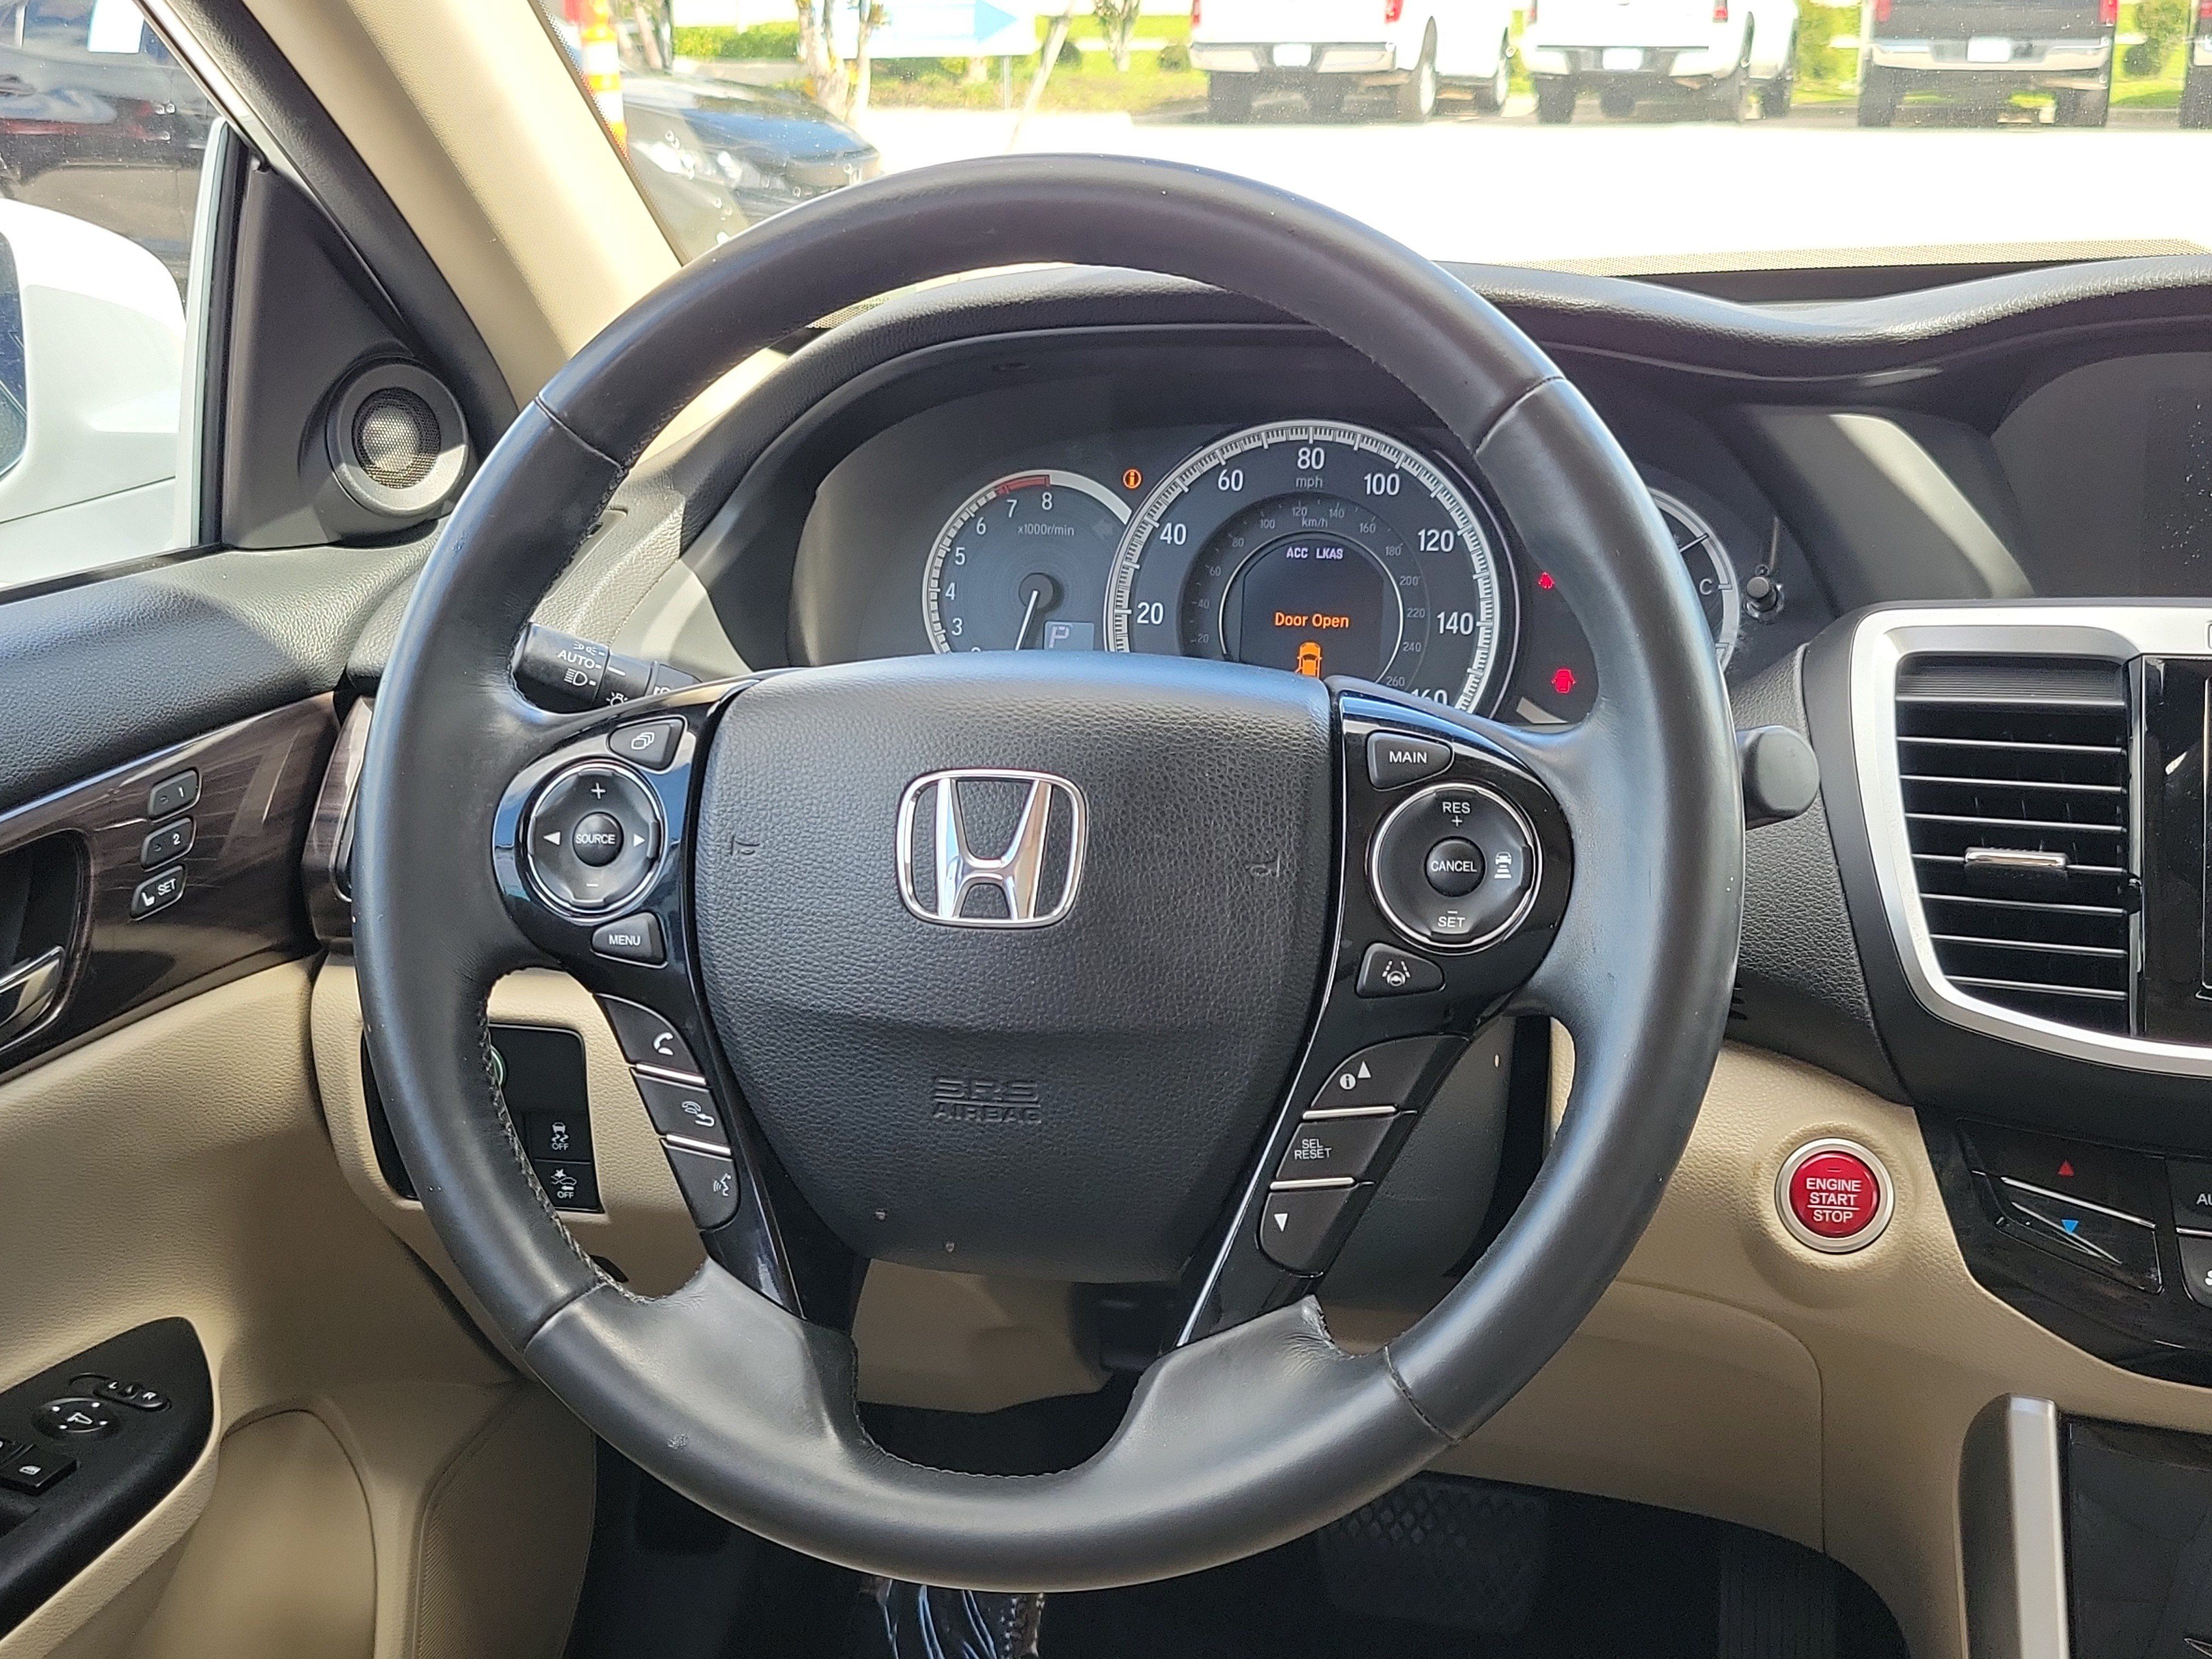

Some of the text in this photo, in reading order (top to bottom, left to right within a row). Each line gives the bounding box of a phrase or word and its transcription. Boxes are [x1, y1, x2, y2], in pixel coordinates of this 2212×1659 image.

[1297, 448, 1325, 470] 80
[1218, 470, 1244, 492] 60
[1296, 476, 1323, 489] mph
[1364, 473, 1400, 496] 100
[1041, 492, 1053, 510] 8
[1007, 500, 1019, 518] 7
[1292, 506, 1307, 517] 120
[1329, 508, 1345, 518] 140
[977, 517, 986, 535] 6
[1260, 519, 1276, 529] 100
[1302, 517, 1328, 528] km/h
[1359, 522, 1376, 533] 160
[1018, 524, 1075, 537] x1000r/min
[1160, 523, 1187, 545] 40
[1232, 537, 1245, 548] 80
[1418, 529, 1455, 552] 120
[955, 548, 966, 566] 5
[1286, 547, 1344, 560] ACC LKAS
[1386, 546, 1401, 556] 180
[1209, 566, 1221, 577] 60
[1400, 575, 1419, 585] 200
[1699, 578, 1713, 595] C
[945, 583, 956, 600] 4
[1198, 599, 1210, 609] 40
[1137, 602, 1164, 624] 20
[1407, 608, 1426, 618] 220
[951, 618, 963, 636] 3
[1275, 612, 1349, 629] Door Open
[1437, 611, 1474, 635] 140
[1048, 626, 1070, 648] P
[1197, 633, 1209, 644] 20
[1403, 641, 1422, 652] 240
[557, 649, 595, 669] AUTO
[1386, 675, 1405, 686] 260
[1389, 751, 1427, 764] MAIN
[178, 787, 184, 797] 1
[1442, 801, 1471, 814] RES
[172, 833, 181, 845] 2
[575, 833, 616, 845] SOURCE
[1430, 860, 1477, 873] CANCEL
[157, 877, 177, 896] SET
[1437, 916, 1466, 928] SET
[608, 934, 641, 946] MENU
[933, 1075, 1040, 1103] SRS
[933, 1103, 1042, 1125] AIRBAG
[551, 1142, 569, 1151] OFF
[1302, 1138, 1323, 1149] SEL
[1294, 1148, 1332, 1160] RESET
[1806, 1177, 1862, 1192] ENGINE
[556, 1190, 574, 1199] OFF
[1809, 1192, 1858, 1206] START
[1813, 1210, 1853, 1223] STOP
